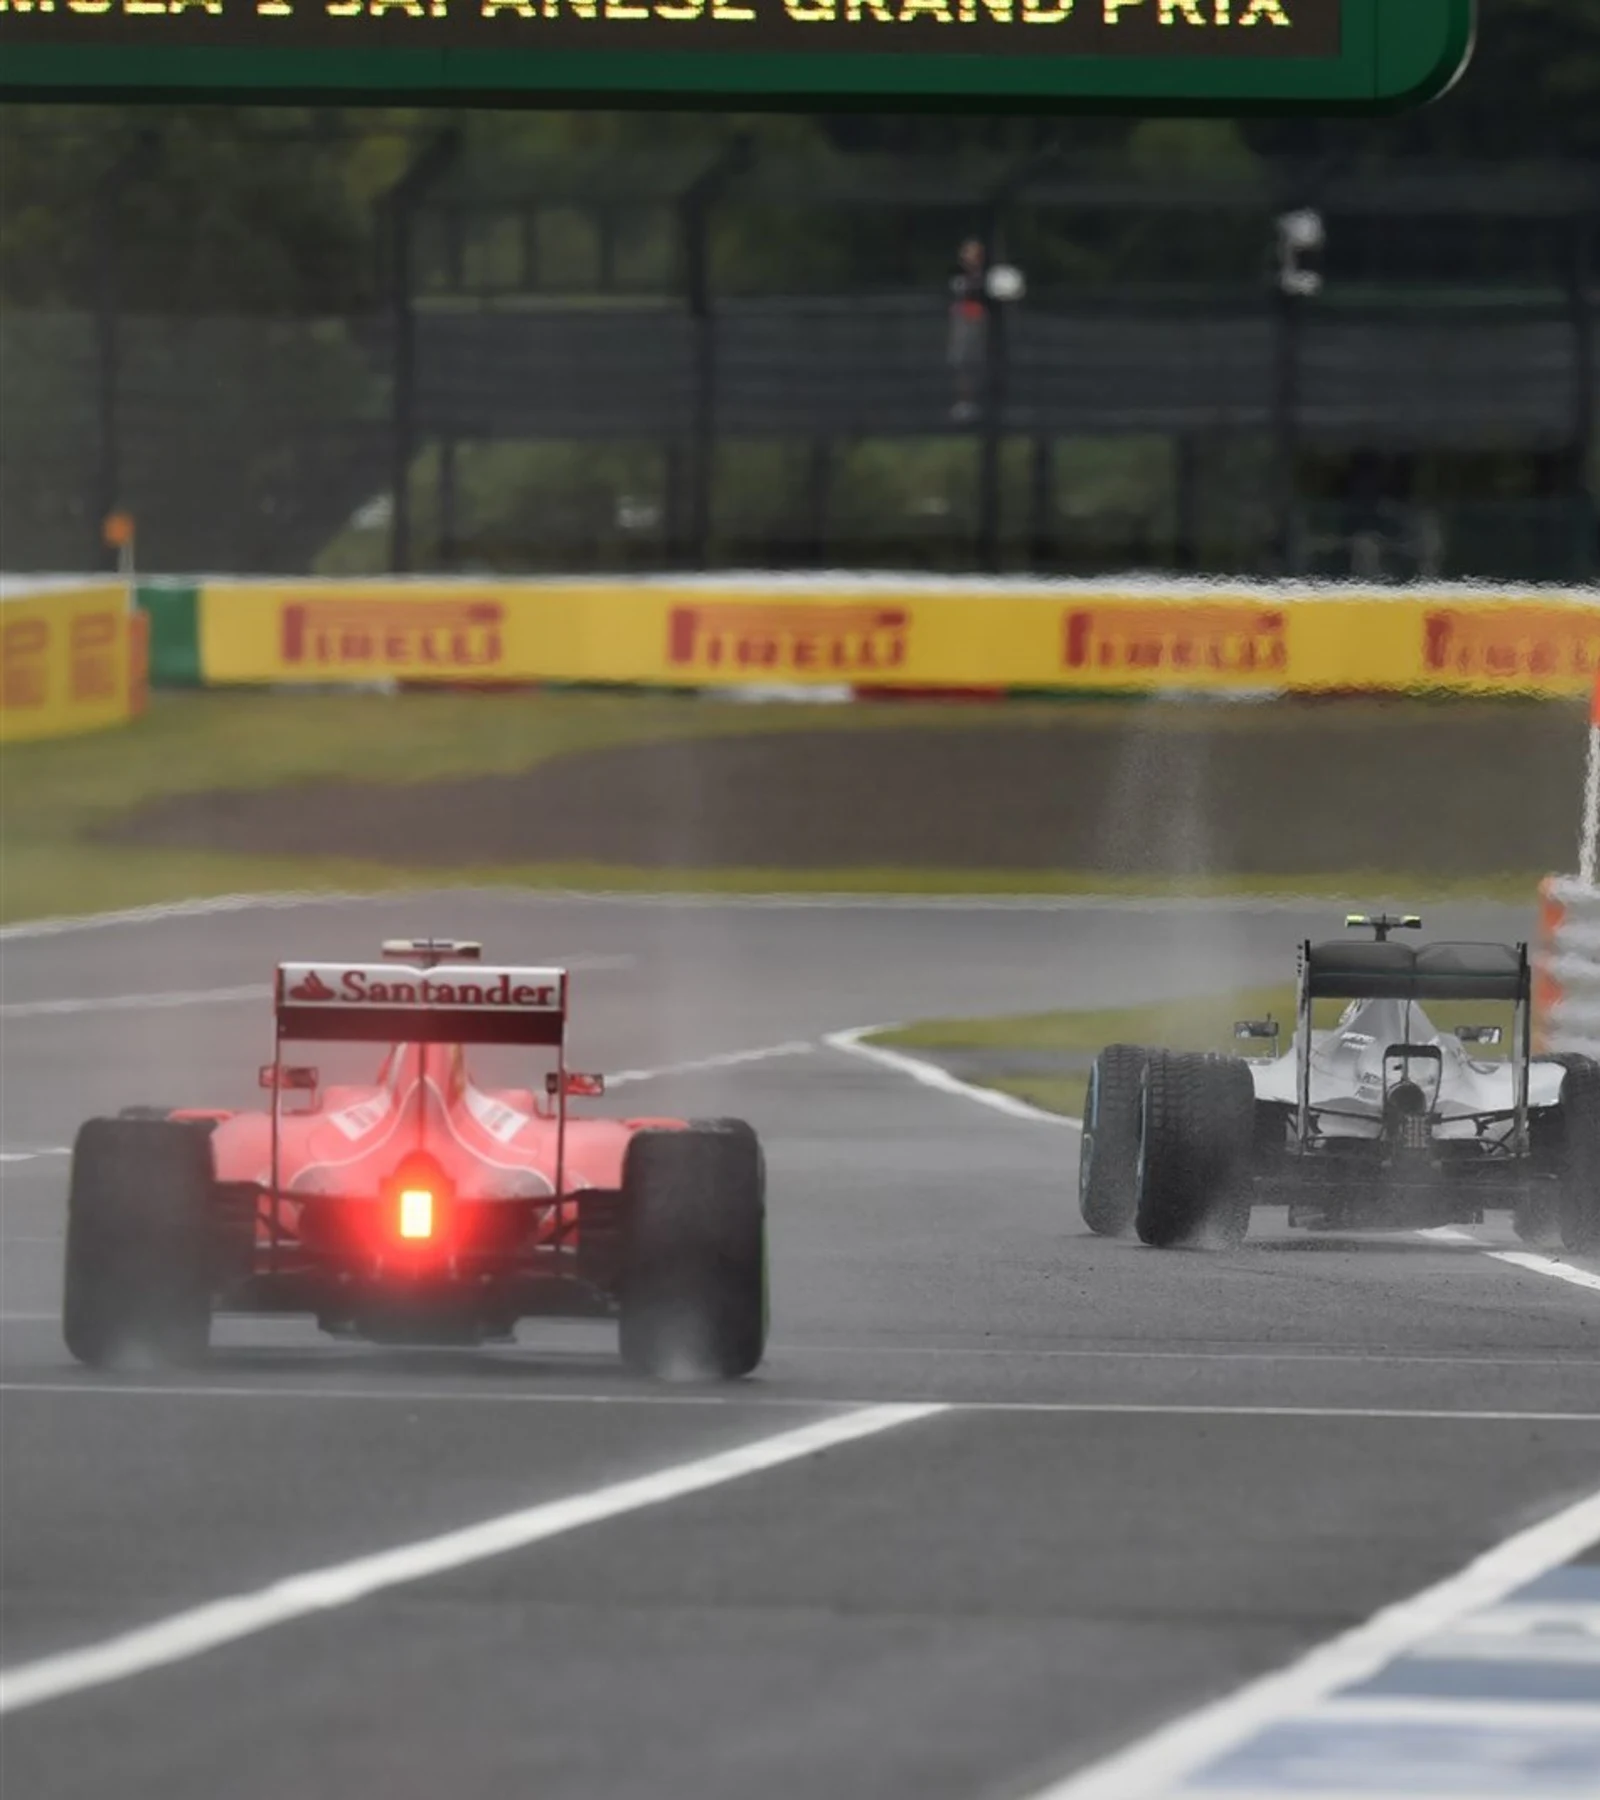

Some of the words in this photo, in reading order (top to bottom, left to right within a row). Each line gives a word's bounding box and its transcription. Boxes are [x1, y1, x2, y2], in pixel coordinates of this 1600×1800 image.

[281, 600, 505, 665] PIRELLI
[667, 603, 910, 670] PIRELLI
[341, 977, 554, 1006] Santander
